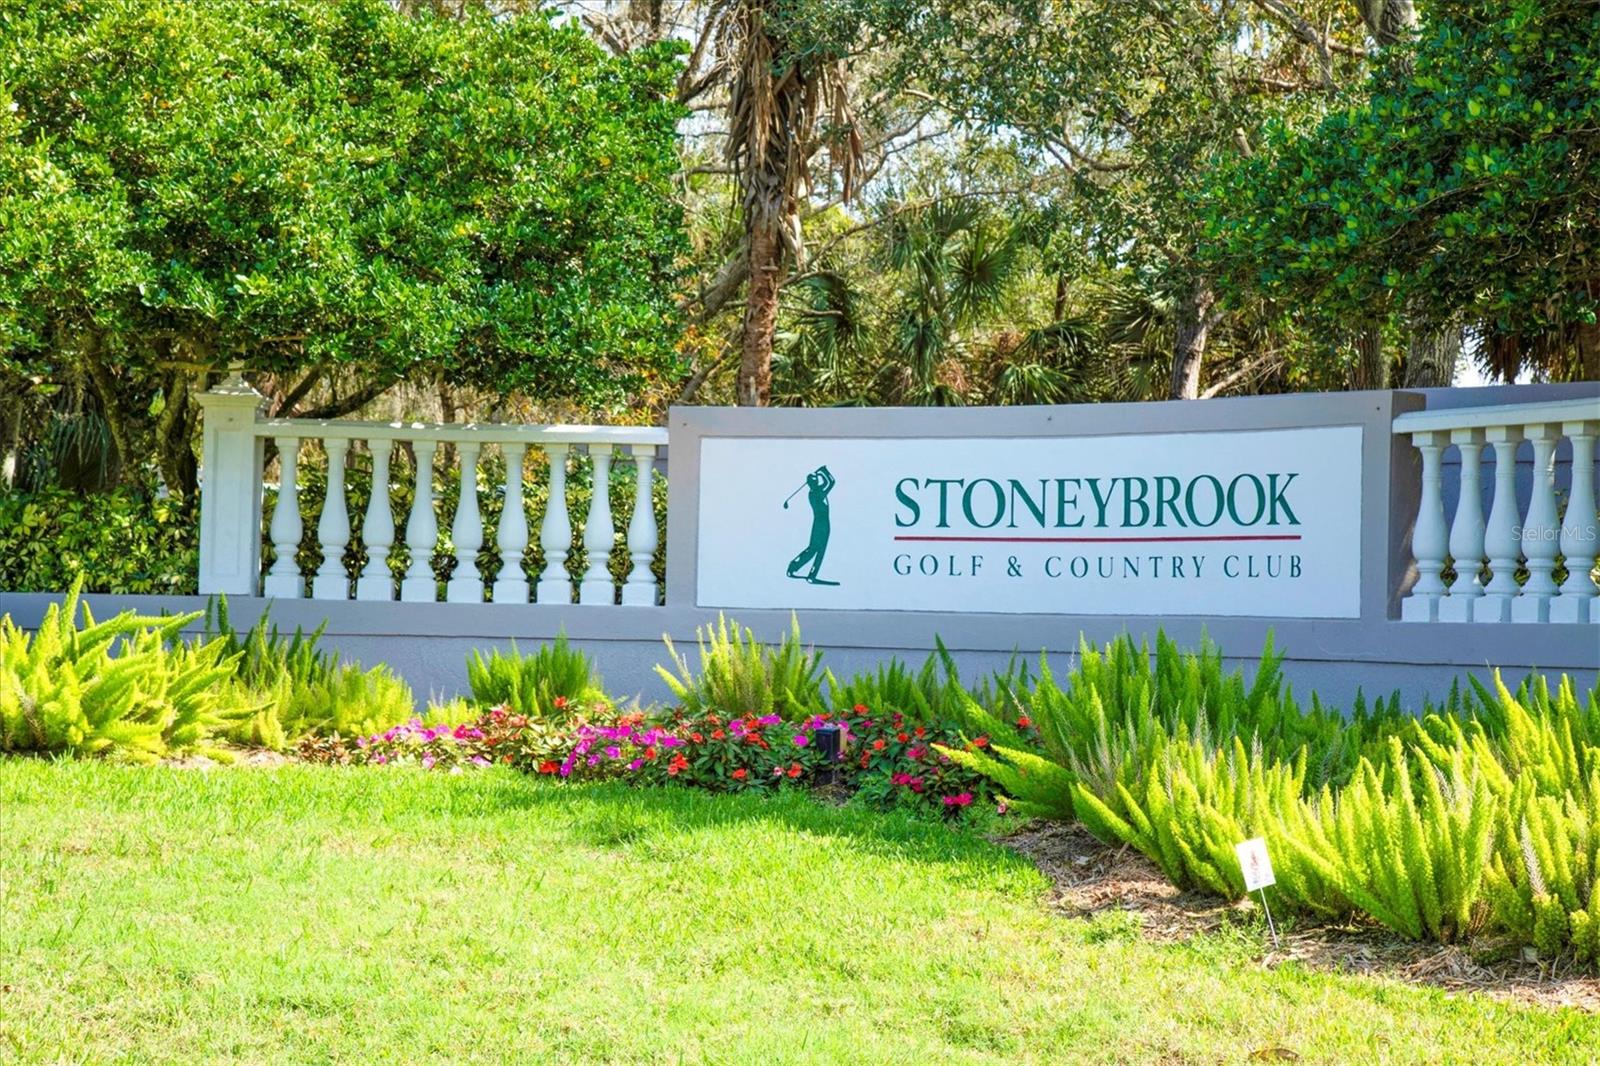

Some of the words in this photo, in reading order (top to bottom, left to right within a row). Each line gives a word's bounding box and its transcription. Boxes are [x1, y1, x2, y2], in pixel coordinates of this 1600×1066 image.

[895, 473, 1301, 528] STONEYBROOK
[893, 554, 983, 577] GOLF
[1007, 556, 1023, 577] &
[1045, 555, 1205, 578] COUNTRY
[1223, 555, 1302, 578] CLUB
